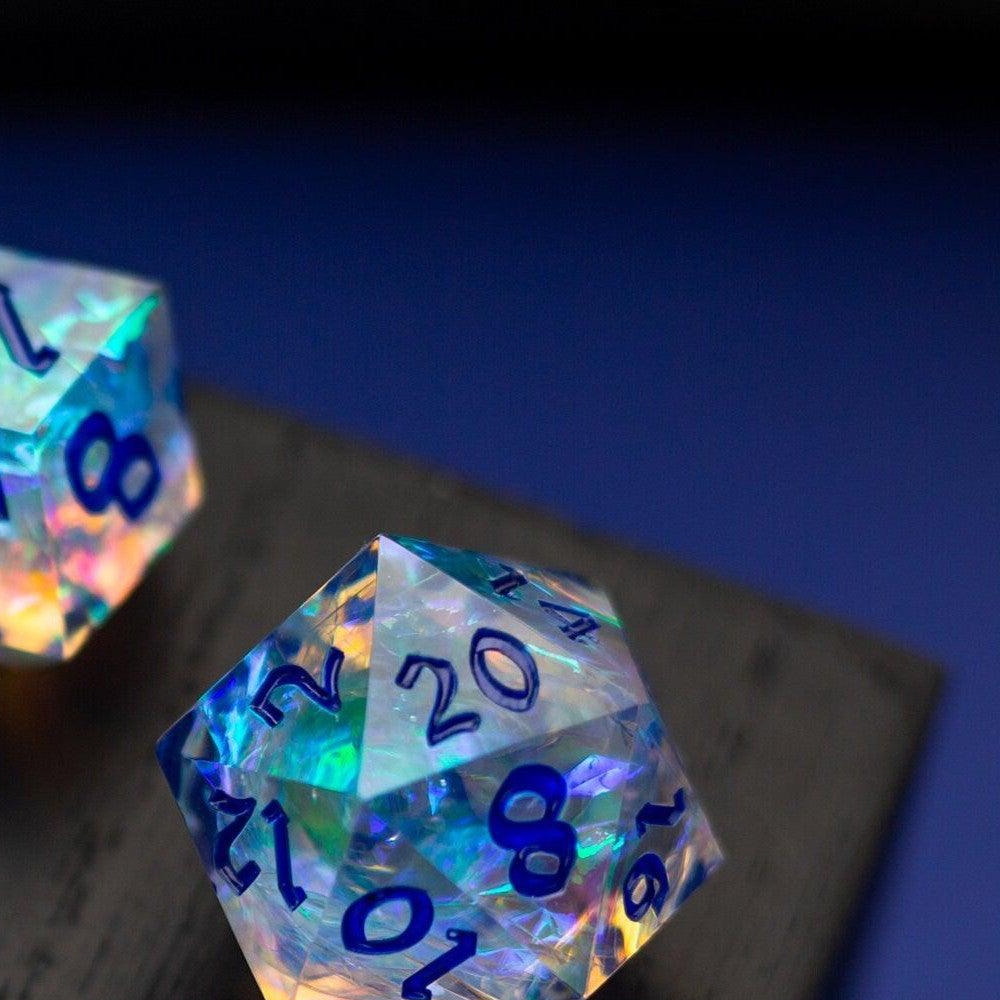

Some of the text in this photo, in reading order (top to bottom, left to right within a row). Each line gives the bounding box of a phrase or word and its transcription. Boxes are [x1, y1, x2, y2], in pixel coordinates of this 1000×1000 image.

[64, 412, 161, 520] 8
[489, 562, 600, 641] 14
[251, 646, 345, 728] 2
[397, 627, 540, 746] 20
[488, 764, 577, 898] 8
